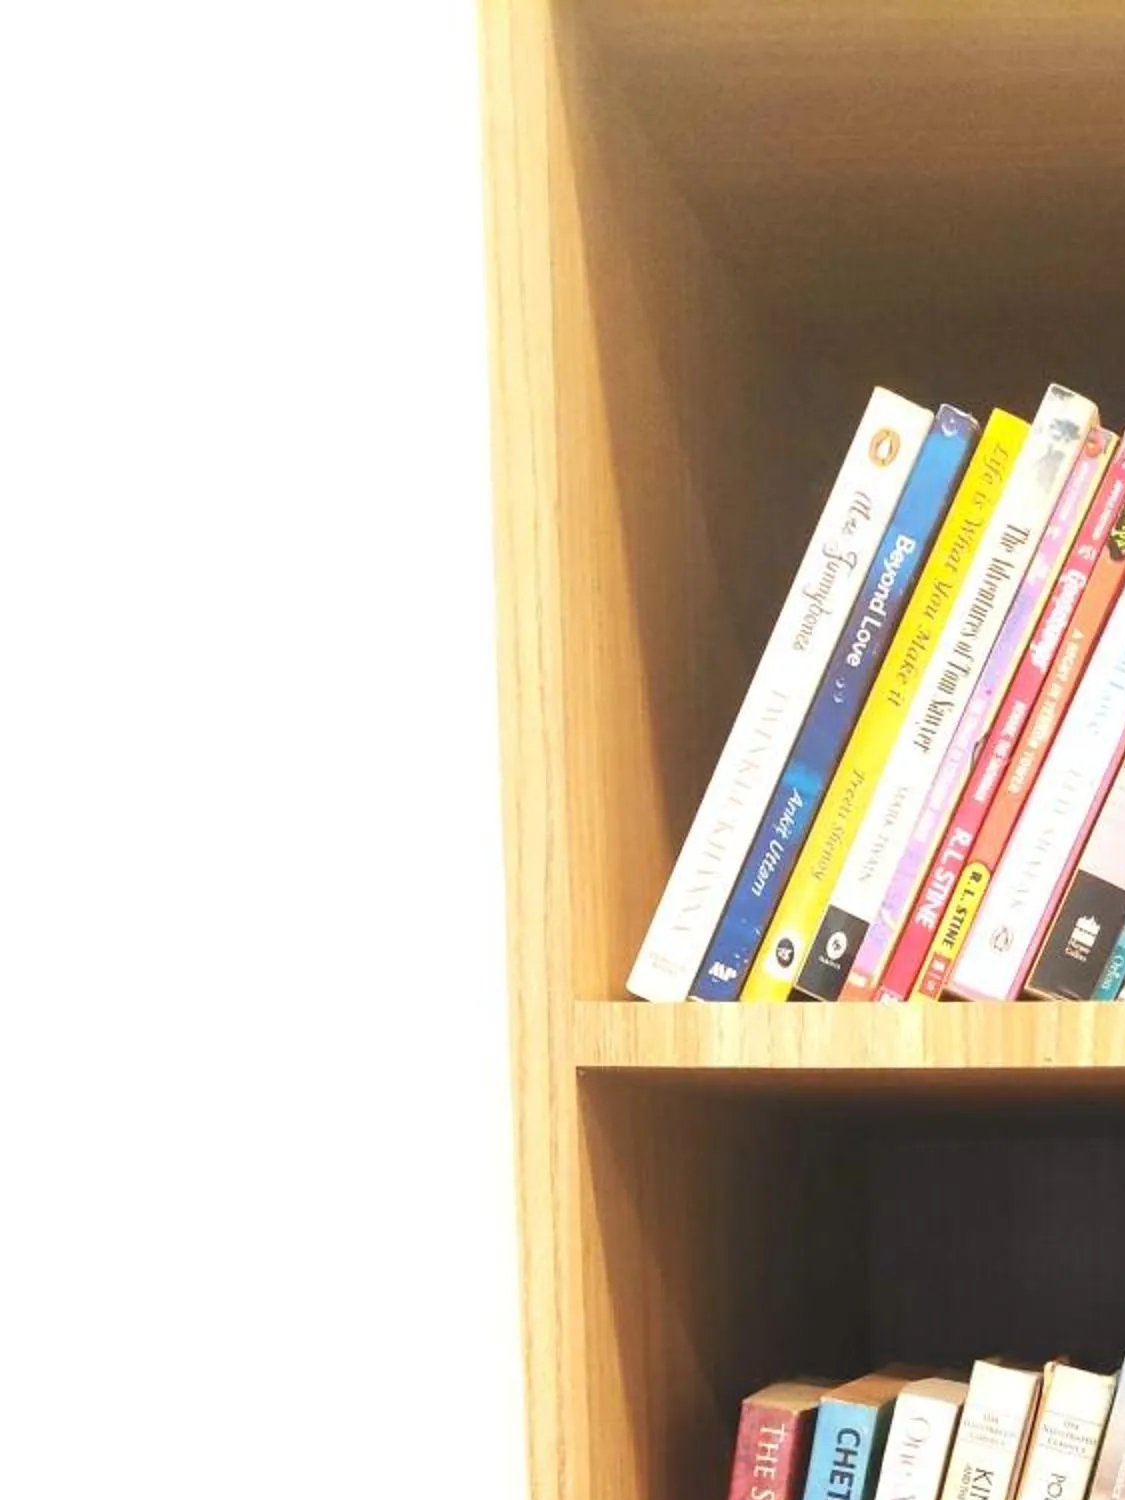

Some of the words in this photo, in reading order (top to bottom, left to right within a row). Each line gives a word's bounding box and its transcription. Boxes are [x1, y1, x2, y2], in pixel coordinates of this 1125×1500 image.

[978, 444, 1011, 487] Life
[969, 489, 991, 511] is
[864, 531, 917, 615] Beyond
[942, 518, 980, 574] What
[920, 577, 954, 622] You
[843, 613, 883, 670] Love
[893, 624, 933, 686] Make
[886, 689, 906, 708] it
[771, 786, 808, 839] Ankit
[747, 838, 787, 899] Uttam
[939, 905, 968, 951] STINE
[751, 1419, 787, 1481] THE
